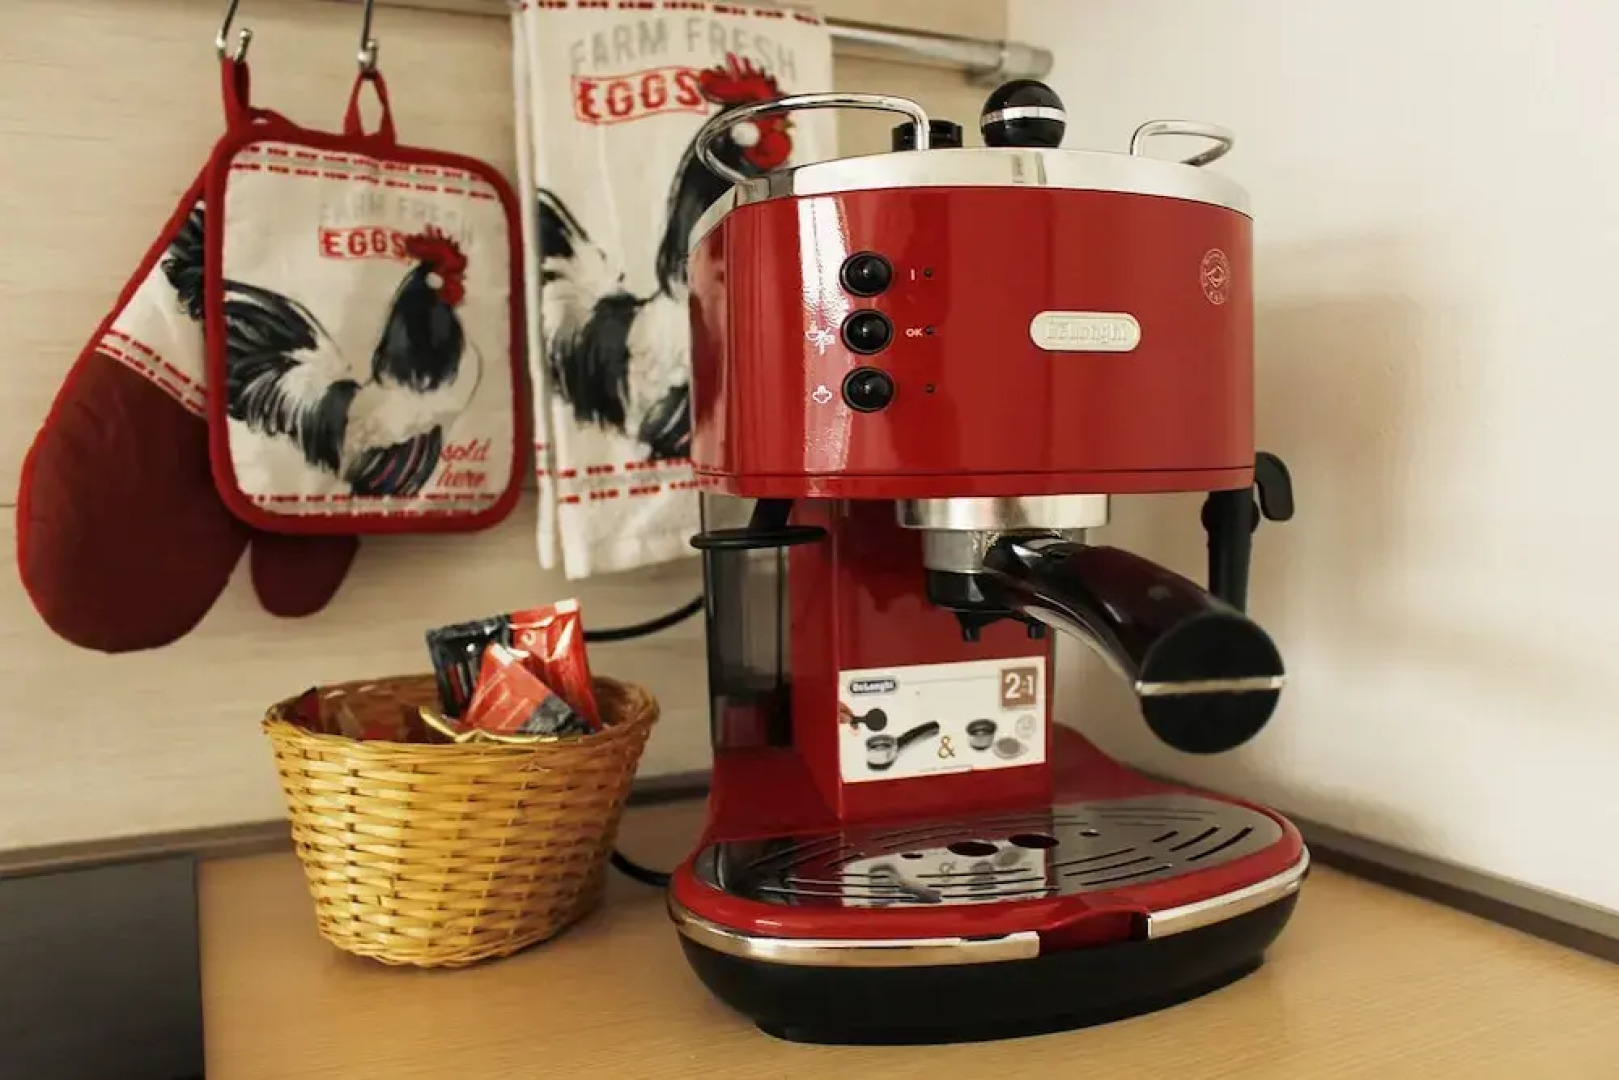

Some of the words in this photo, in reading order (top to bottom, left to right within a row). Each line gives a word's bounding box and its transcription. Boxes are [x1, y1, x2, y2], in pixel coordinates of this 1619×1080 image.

[569, 18, 669, 73] FARM
[685, 17, 797, 81] FRESH
[576, 69, 702, 119] EGGS
[324, 229, 406, 257] EGGS
[905, 328, 924, 337] OK
[440, 438, 490, 461] sold
[938, 735, 955, 759] &
